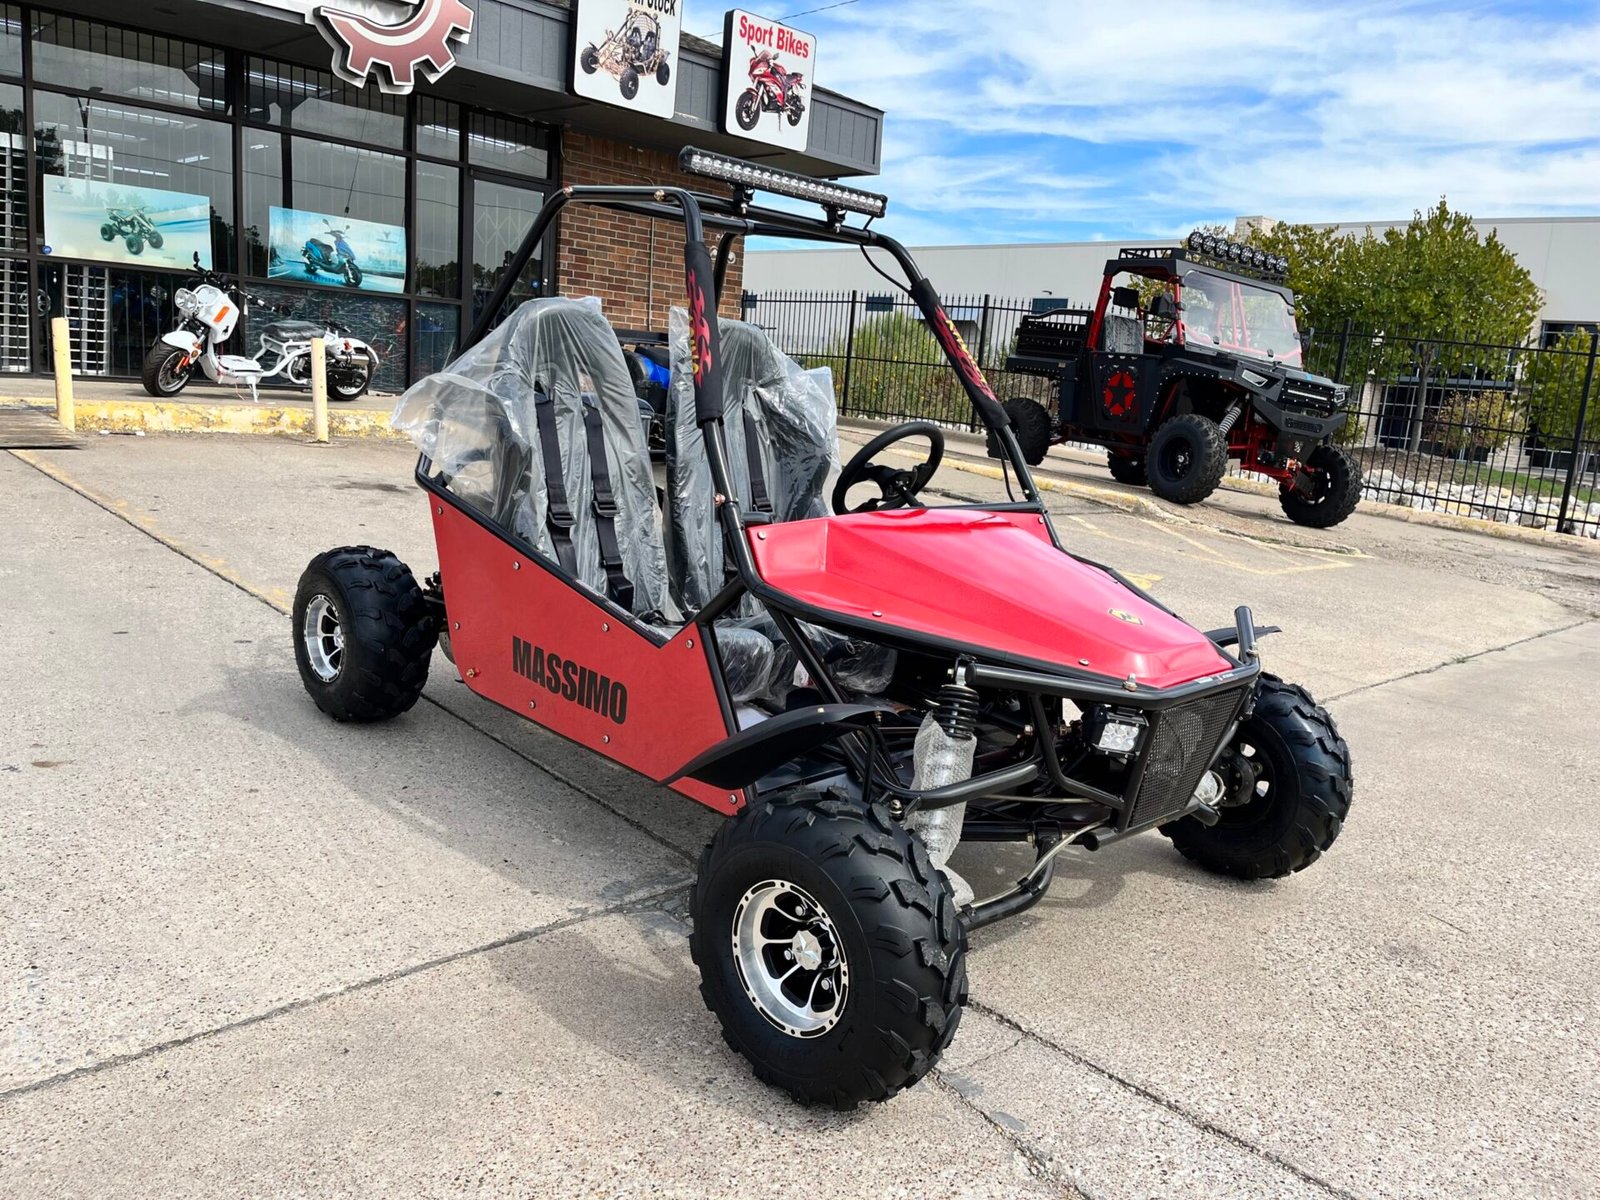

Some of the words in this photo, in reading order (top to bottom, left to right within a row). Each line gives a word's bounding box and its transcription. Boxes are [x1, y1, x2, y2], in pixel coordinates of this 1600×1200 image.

[739, 15, 773, 47] Sport
[776, 28, 809, 58] Bikes
[512, 635, 628, 725] MASSIMO
